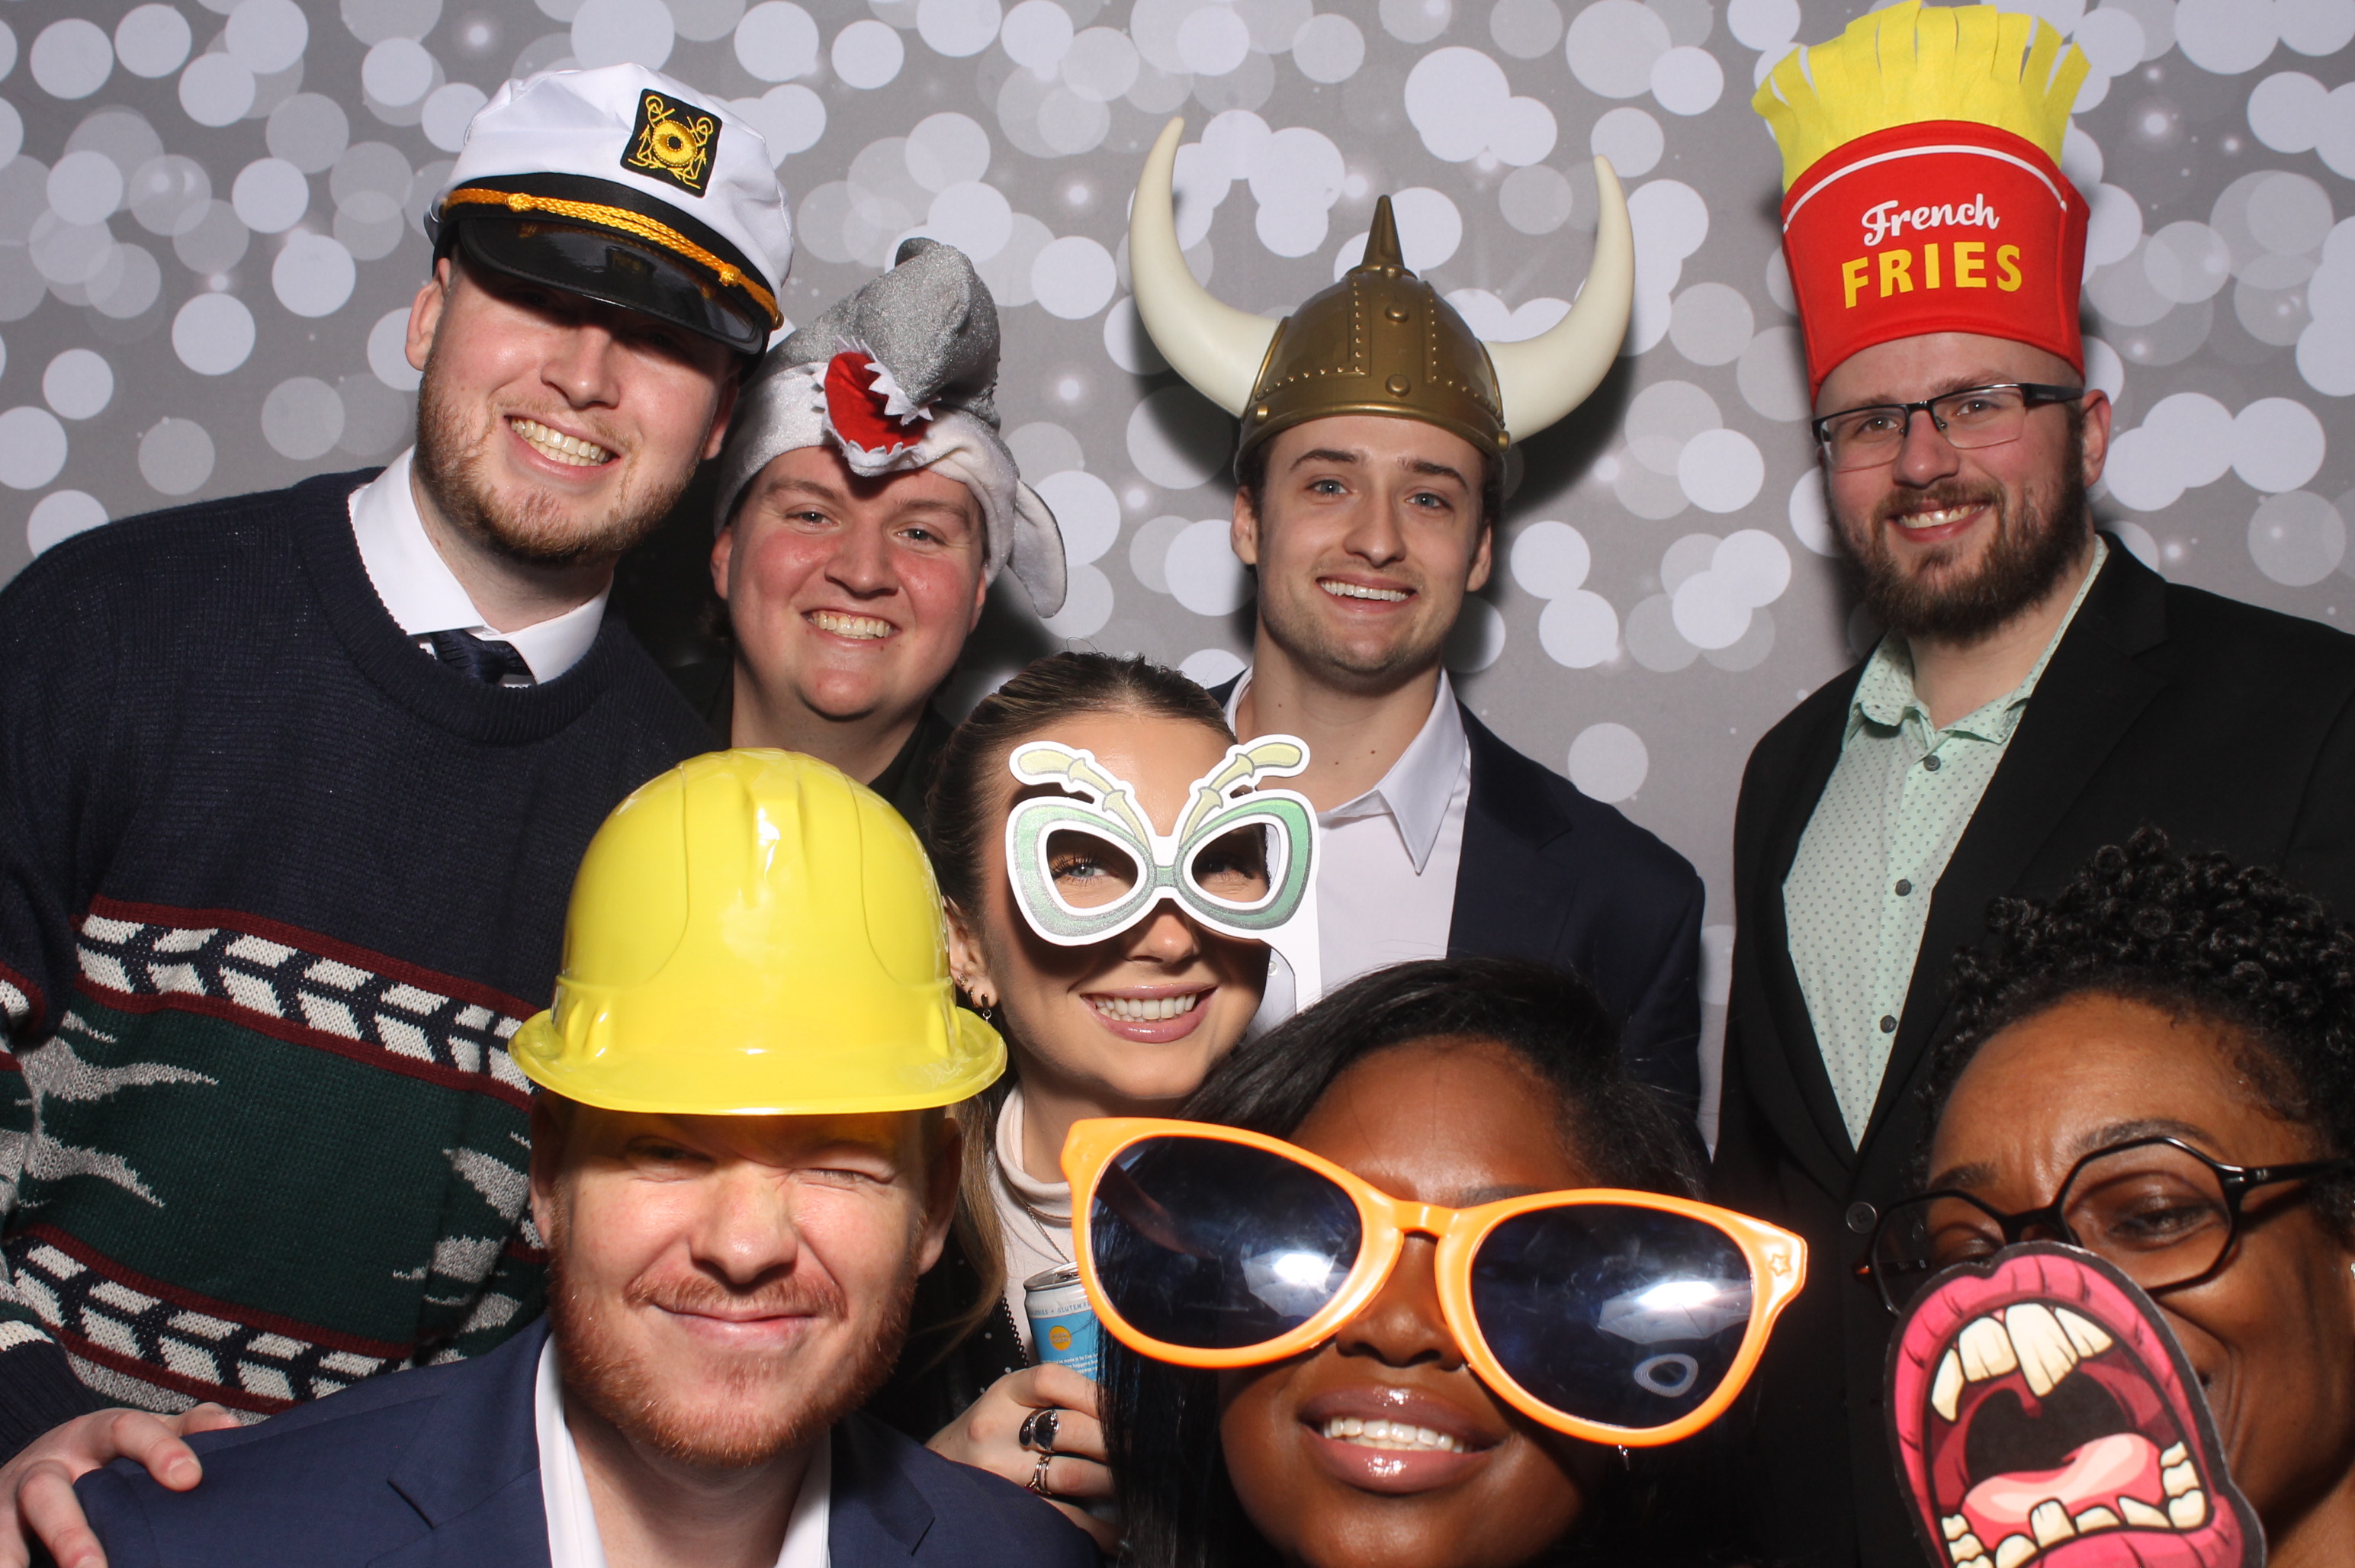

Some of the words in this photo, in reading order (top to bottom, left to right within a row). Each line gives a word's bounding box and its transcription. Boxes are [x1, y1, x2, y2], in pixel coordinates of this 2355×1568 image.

[1862, 193, 2000, 246] French
[1842, 241, 2022, 309] FRIES
[1057, 1303, 1082, 1313] GLUTEN
